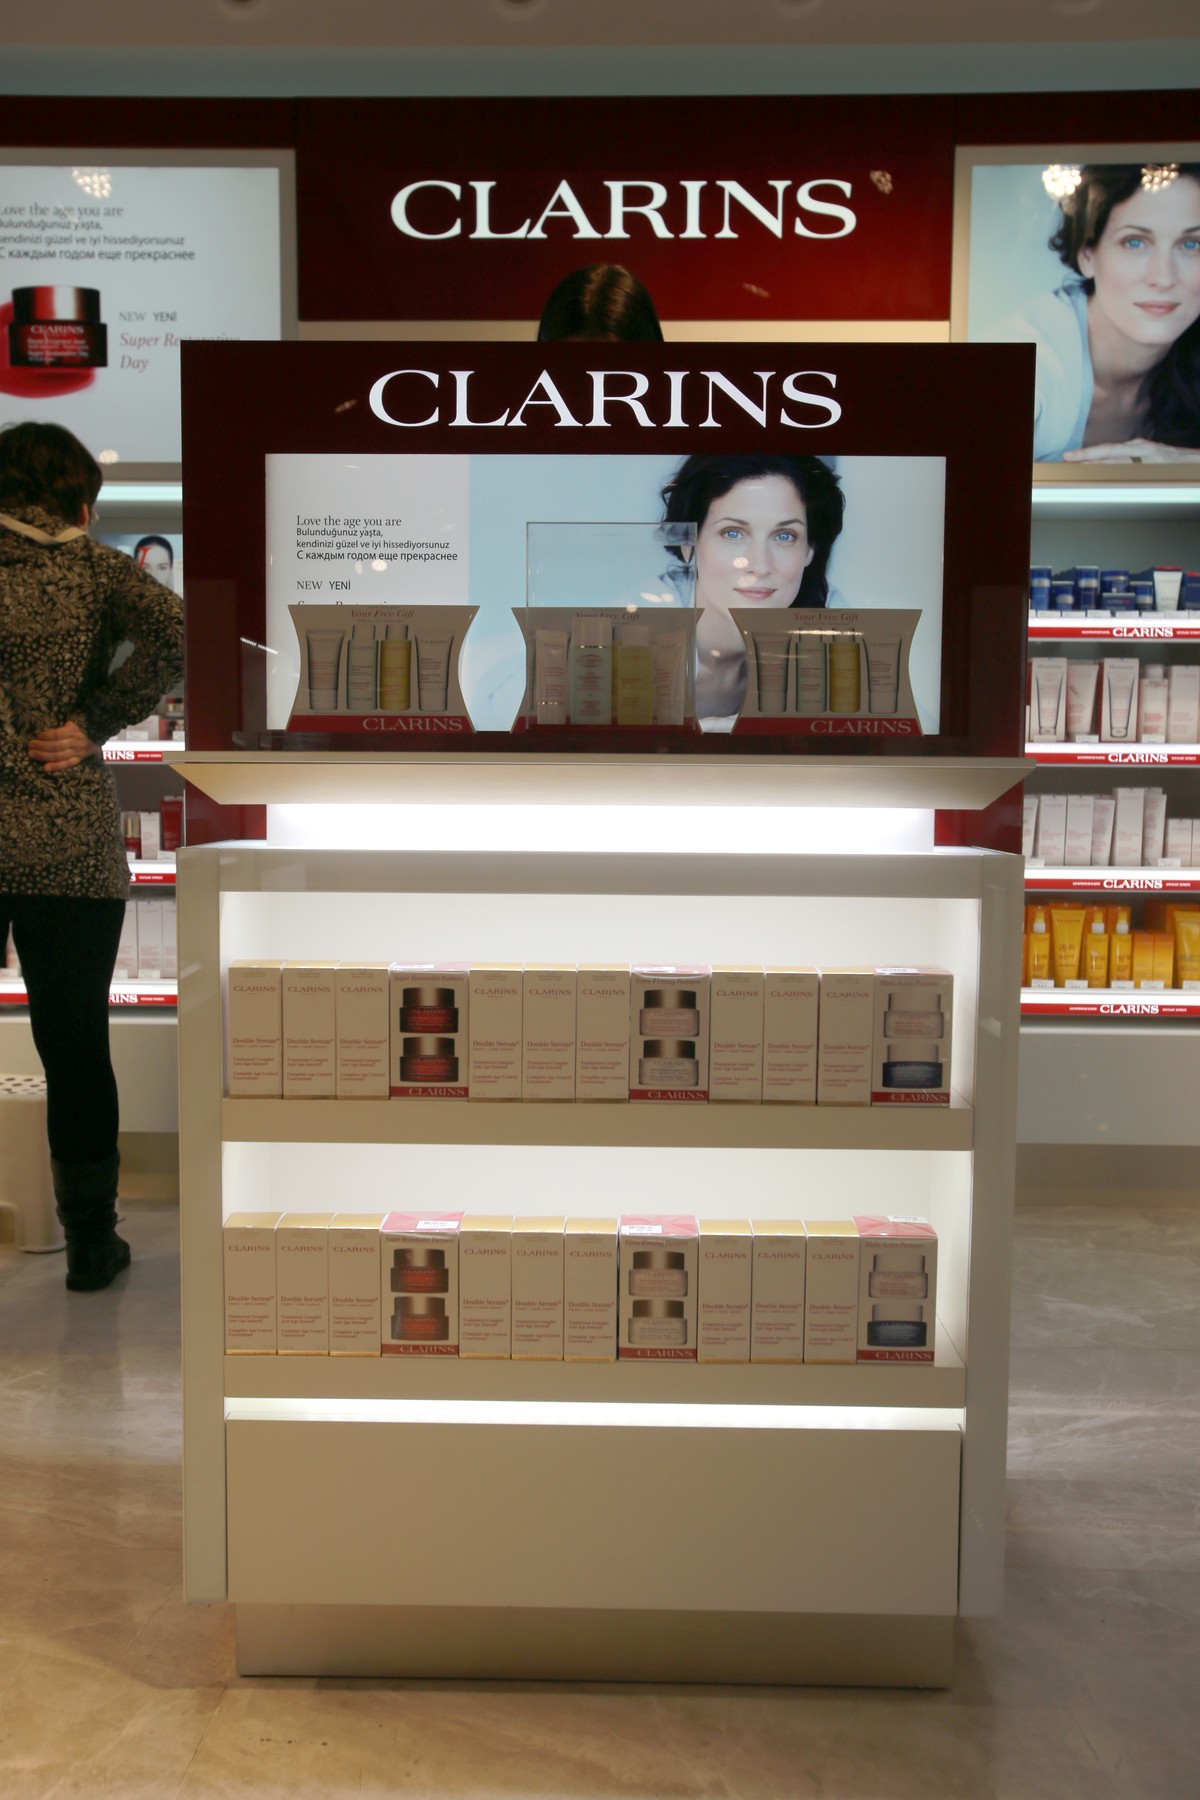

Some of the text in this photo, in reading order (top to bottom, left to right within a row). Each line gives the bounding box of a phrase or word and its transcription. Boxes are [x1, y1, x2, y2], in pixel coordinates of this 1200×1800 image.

[30, 202, 49, 216] the
[53, 206, 75, 220] age
[78, 206, 100, 220] you
[104, 206, 123, 217] are
[391, 179, 856, 239] CLARINS
[45, 234, 72, 246] güzel
[89, 235, 100, 247] iyi
[103, 235, 184, 247] hissediyorsunuz
[8, 249, 56, 260] каждым
[59, 249, 94, 260] годом
[125, 249, 195, 261] прекраснее
[119, 312, 146, 321] NEW
[120, 332, 160, 350] Super
[120, 355, 148, 372] Day
[369, 370, 841, 428] CLARINS
[297, 516, 321, 526] Love
[324, 516, 340, 526] the
[344, 518, 360, 528] age
[364, 518, 383, 529] you
[297, 528, 383, 537] Bulunduğunuz yaşta,
[297, 540, 333, 548] kendinizi
[336, 540, 358, 549] güzel
[372, 541, 381, 549] iyi
[384, 541, 449, 550] hissediyorsunuz
[306, 553, 344, 561] каждым
[347, 553, 376, 561] годом
[379, 553, 398, 561] еще
[401, 553, 458, 562] прекраснее
[297, 580, 350, 590] NEW YENİ
[351, 609, 414, 618] Your Free Gift
[794, 613, 858, 622] Your Free Gift
[1113, 627, 1173, 637] CLARINS
[363, 718, 462, 731] CLARINS
[810, 720, 911, 734] CLARINS
[103, 751, 135, 760] RINS
[1108, 753, 1168, 763] CLARINS
[1103, 879, 1163, 889] CLARINS
[233, 985, 276, 993] CLARINS
[287, 985, 330, 993] CLARINS
[474, 988, 517, 996] CLARINS
[529, 988, 572, 996] CLARINS
[582, 988, 625, 996] CLARINS
[109, 994, 138, 1003] RINS
[716, 990, 759, 998] CLARINS
[770, 990, 813, 998] CLARINS
[826, 991, 869, 999] CLARINS
[1100, 1004, 1159, 1014] CLARINS
[409, 1088, 465, 1096] CLARINS
[647, 1090, 704, 1099] CLARINS
[891, 1093, 948, 1102] CLARINS
[228, 1245, 270, 1253] CLARINS
[281, 1245, 323, 1253] CLARINS
[464, 1248, 506, 1256] CLARINS
[569, 1250, 612, 1258] CLARINS
[400, 1345, 456, 1354] CLARINS
[637, 1349, 693, 1357] CLARINS
[876, 1351, 932, 1360] CLARINS
